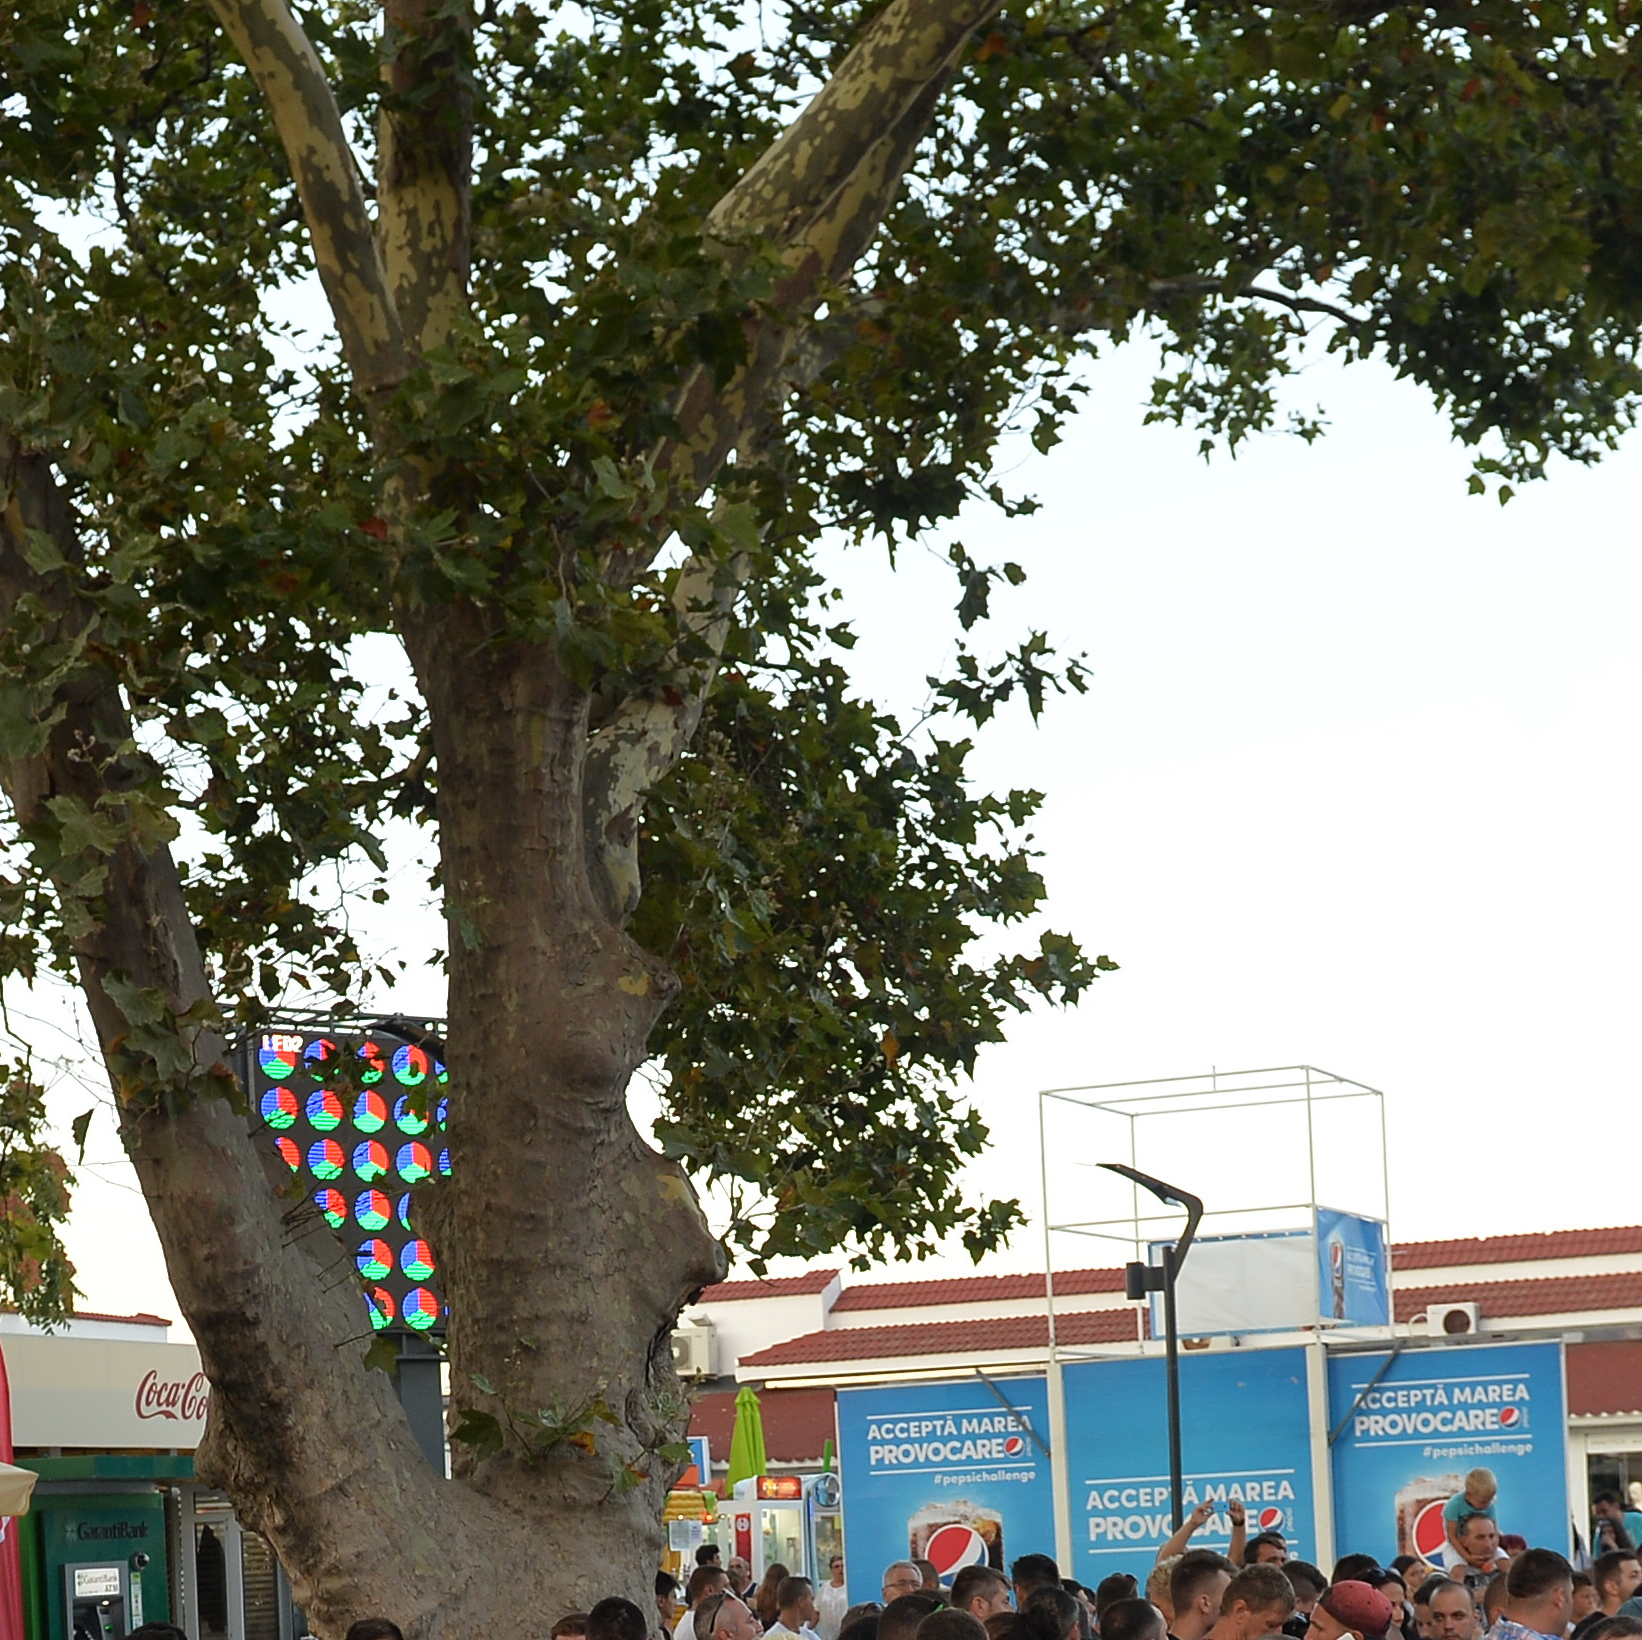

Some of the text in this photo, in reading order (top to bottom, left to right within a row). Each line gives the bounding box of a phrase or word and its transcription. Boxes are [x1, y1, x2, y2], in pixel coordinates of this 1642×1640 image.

[135, 1369, 209, 1421] Coca-Co
[1352, 1383, 1530, 1410] ACCEPTĂ MAREA
[866, 1414, 1033, 1441] ACCEPTĂ MAREA
[1354, 1408, 1500, 1437] PROVOCARE
[869, 1438, 1005, 1466] PROVOCARE
[1422, 1442, 1533, 1460] #pepsichallenge
[933, 1470, 1036, 1487] #pepsichallenge
[1085, 1480, 1295, 1511] ACCEPĂ MAREA
[77, 1520, 150, 1540] GarantiBank
